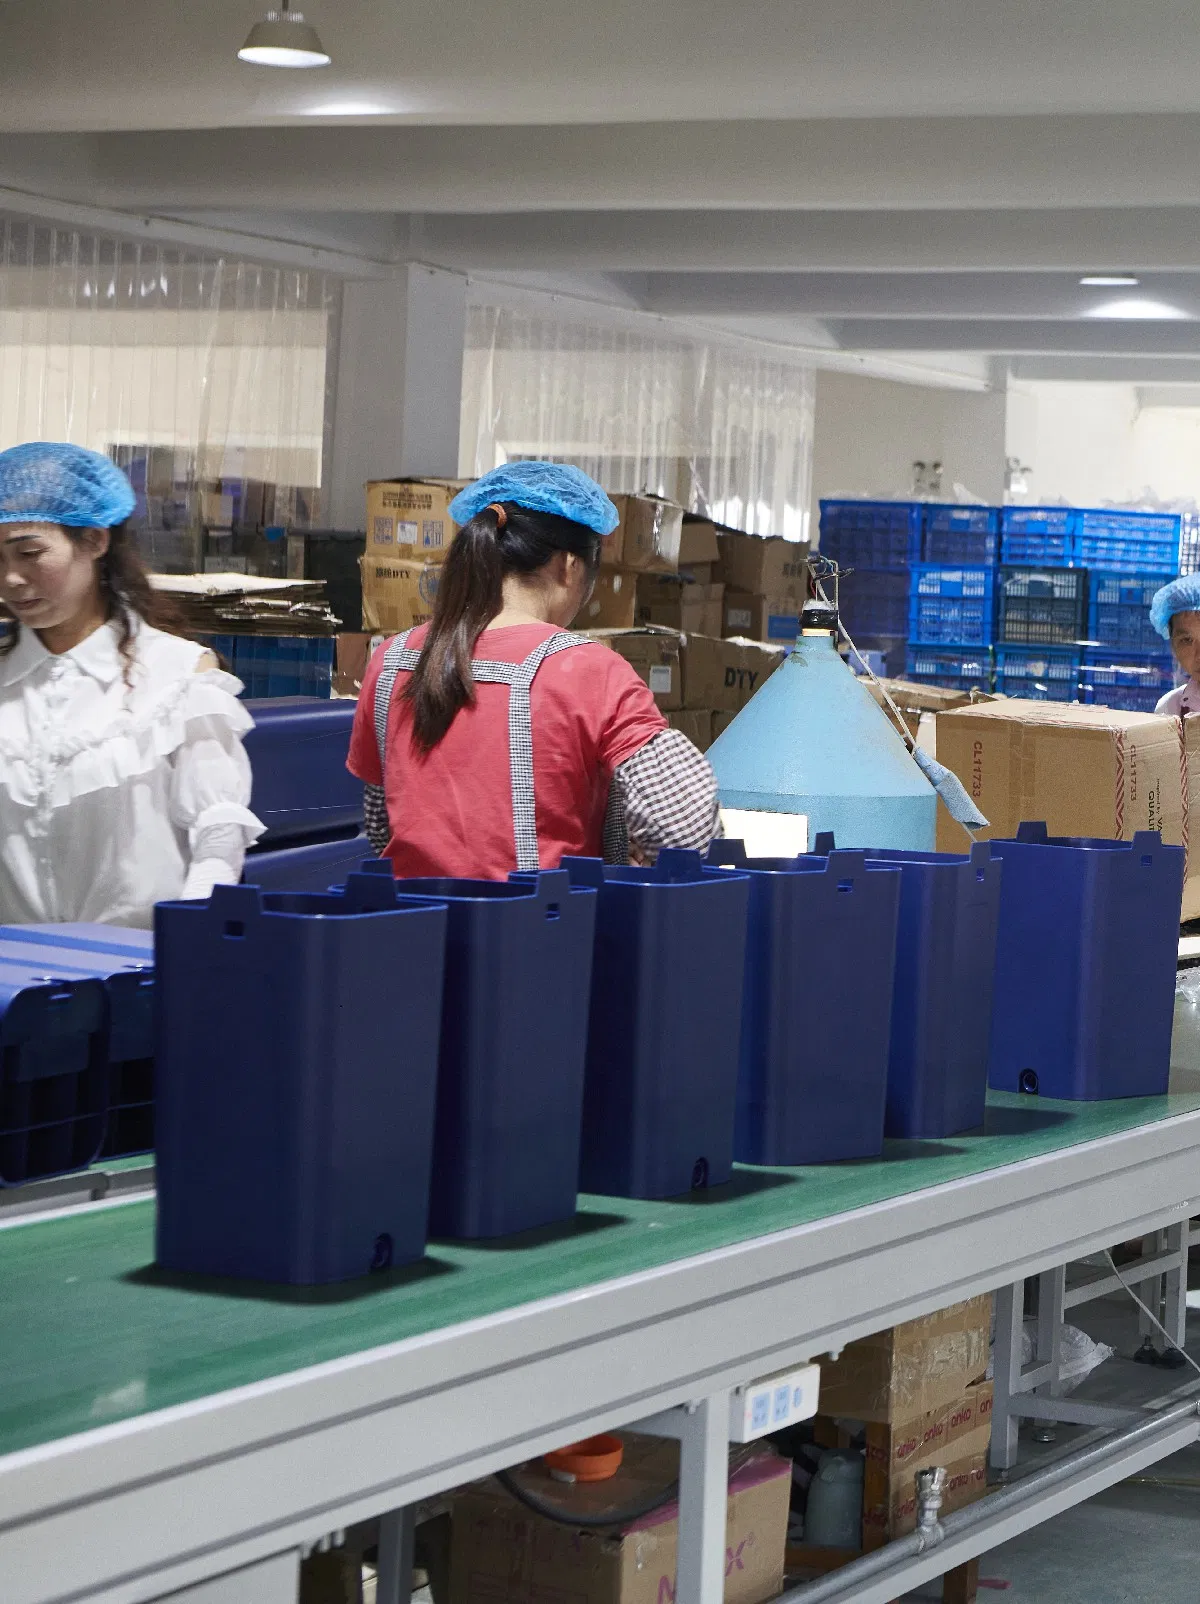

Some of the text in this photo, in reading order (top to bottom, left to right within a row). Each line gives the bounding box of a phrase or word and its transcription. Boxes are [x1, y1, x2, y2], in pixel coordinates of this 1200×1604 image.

[725, 667, 759, 690] DTY
[973, 741, 983, 798] CL11733
[1129, 744, 1138, 802] CL11733
[896, 1438, 917, 1459] anko
[923, 1422, 943, 1443] anko
[950, 1407, 972, 1428] anko
[979, 1398, 993, 1413] an
[949, 1473, 969, 1490] anko
